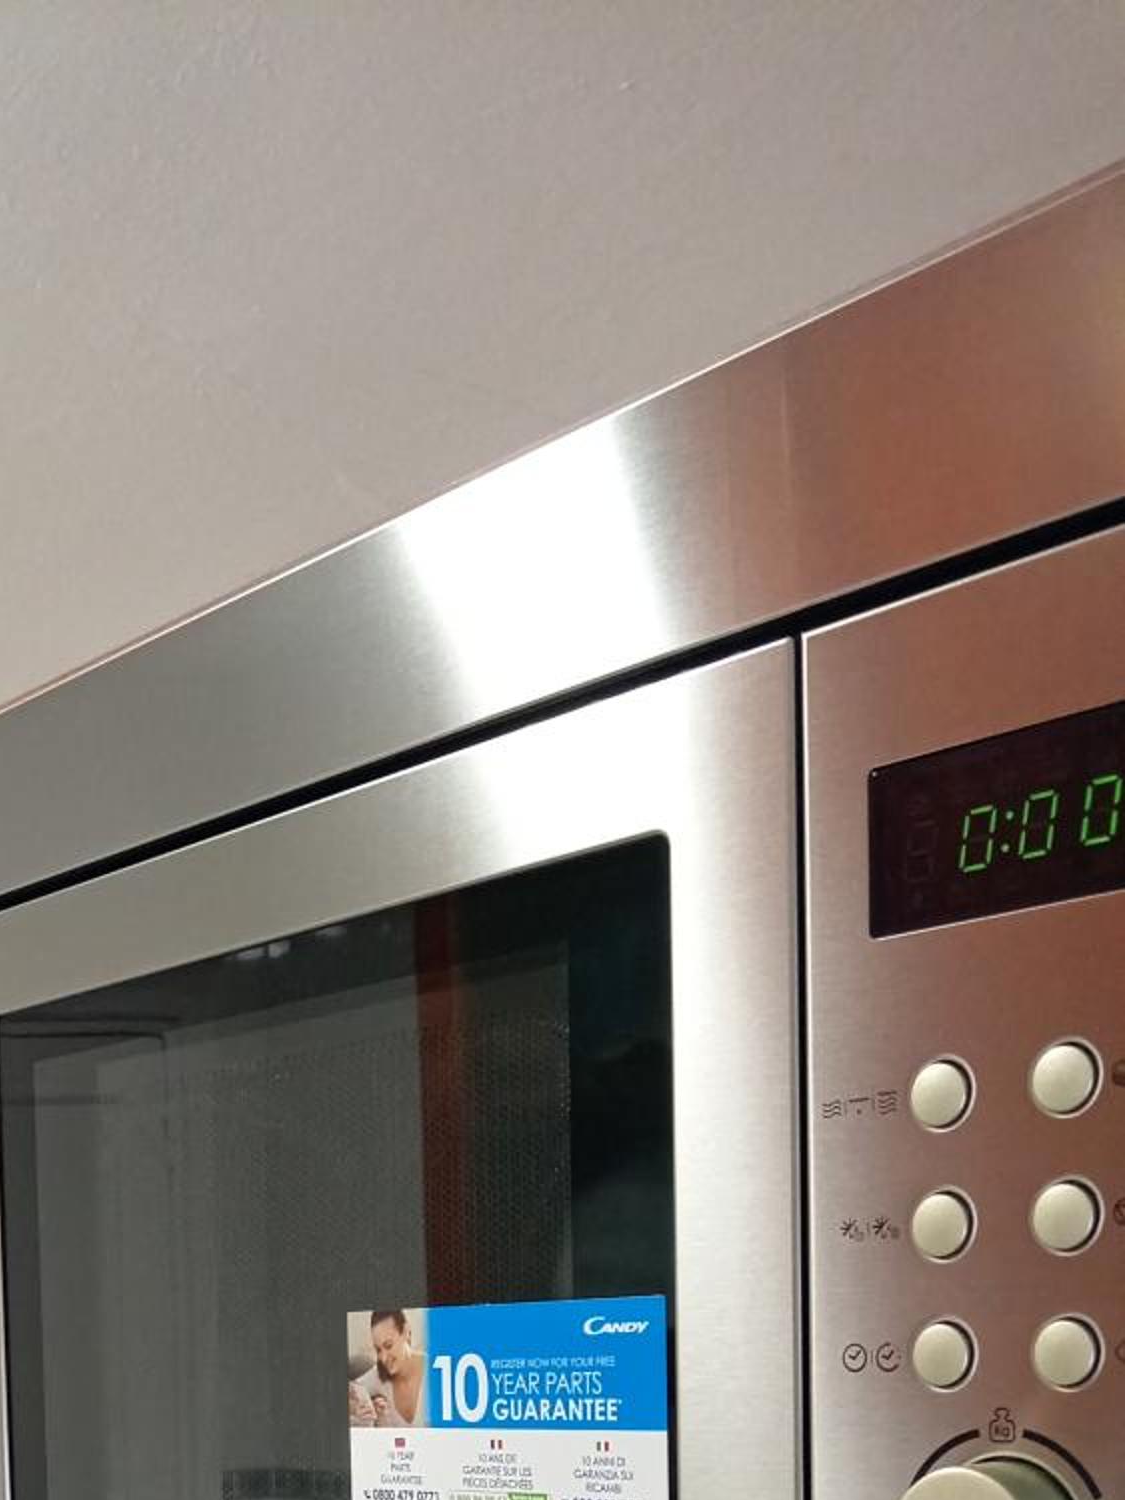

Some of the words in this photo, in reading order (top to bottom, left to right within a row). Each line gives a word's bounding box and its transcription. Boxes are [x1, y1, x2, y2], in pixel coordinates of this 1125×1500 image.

[491, 1358, 525, 1369] REGISTER
[527, 1358, 549, 1368] NOW
[551, 1357, 568, 1368] FOR
[570, 1356, 594, 1367] YOUR
[596, 1355, 616, 1367] FREE
[432, 1353, 489, 1422] 10
[491, 1372, 540, 1395] YEAR
[546, 1371, 603, 1395] PARTS
[373, 1489, 395, 1500] 0800
